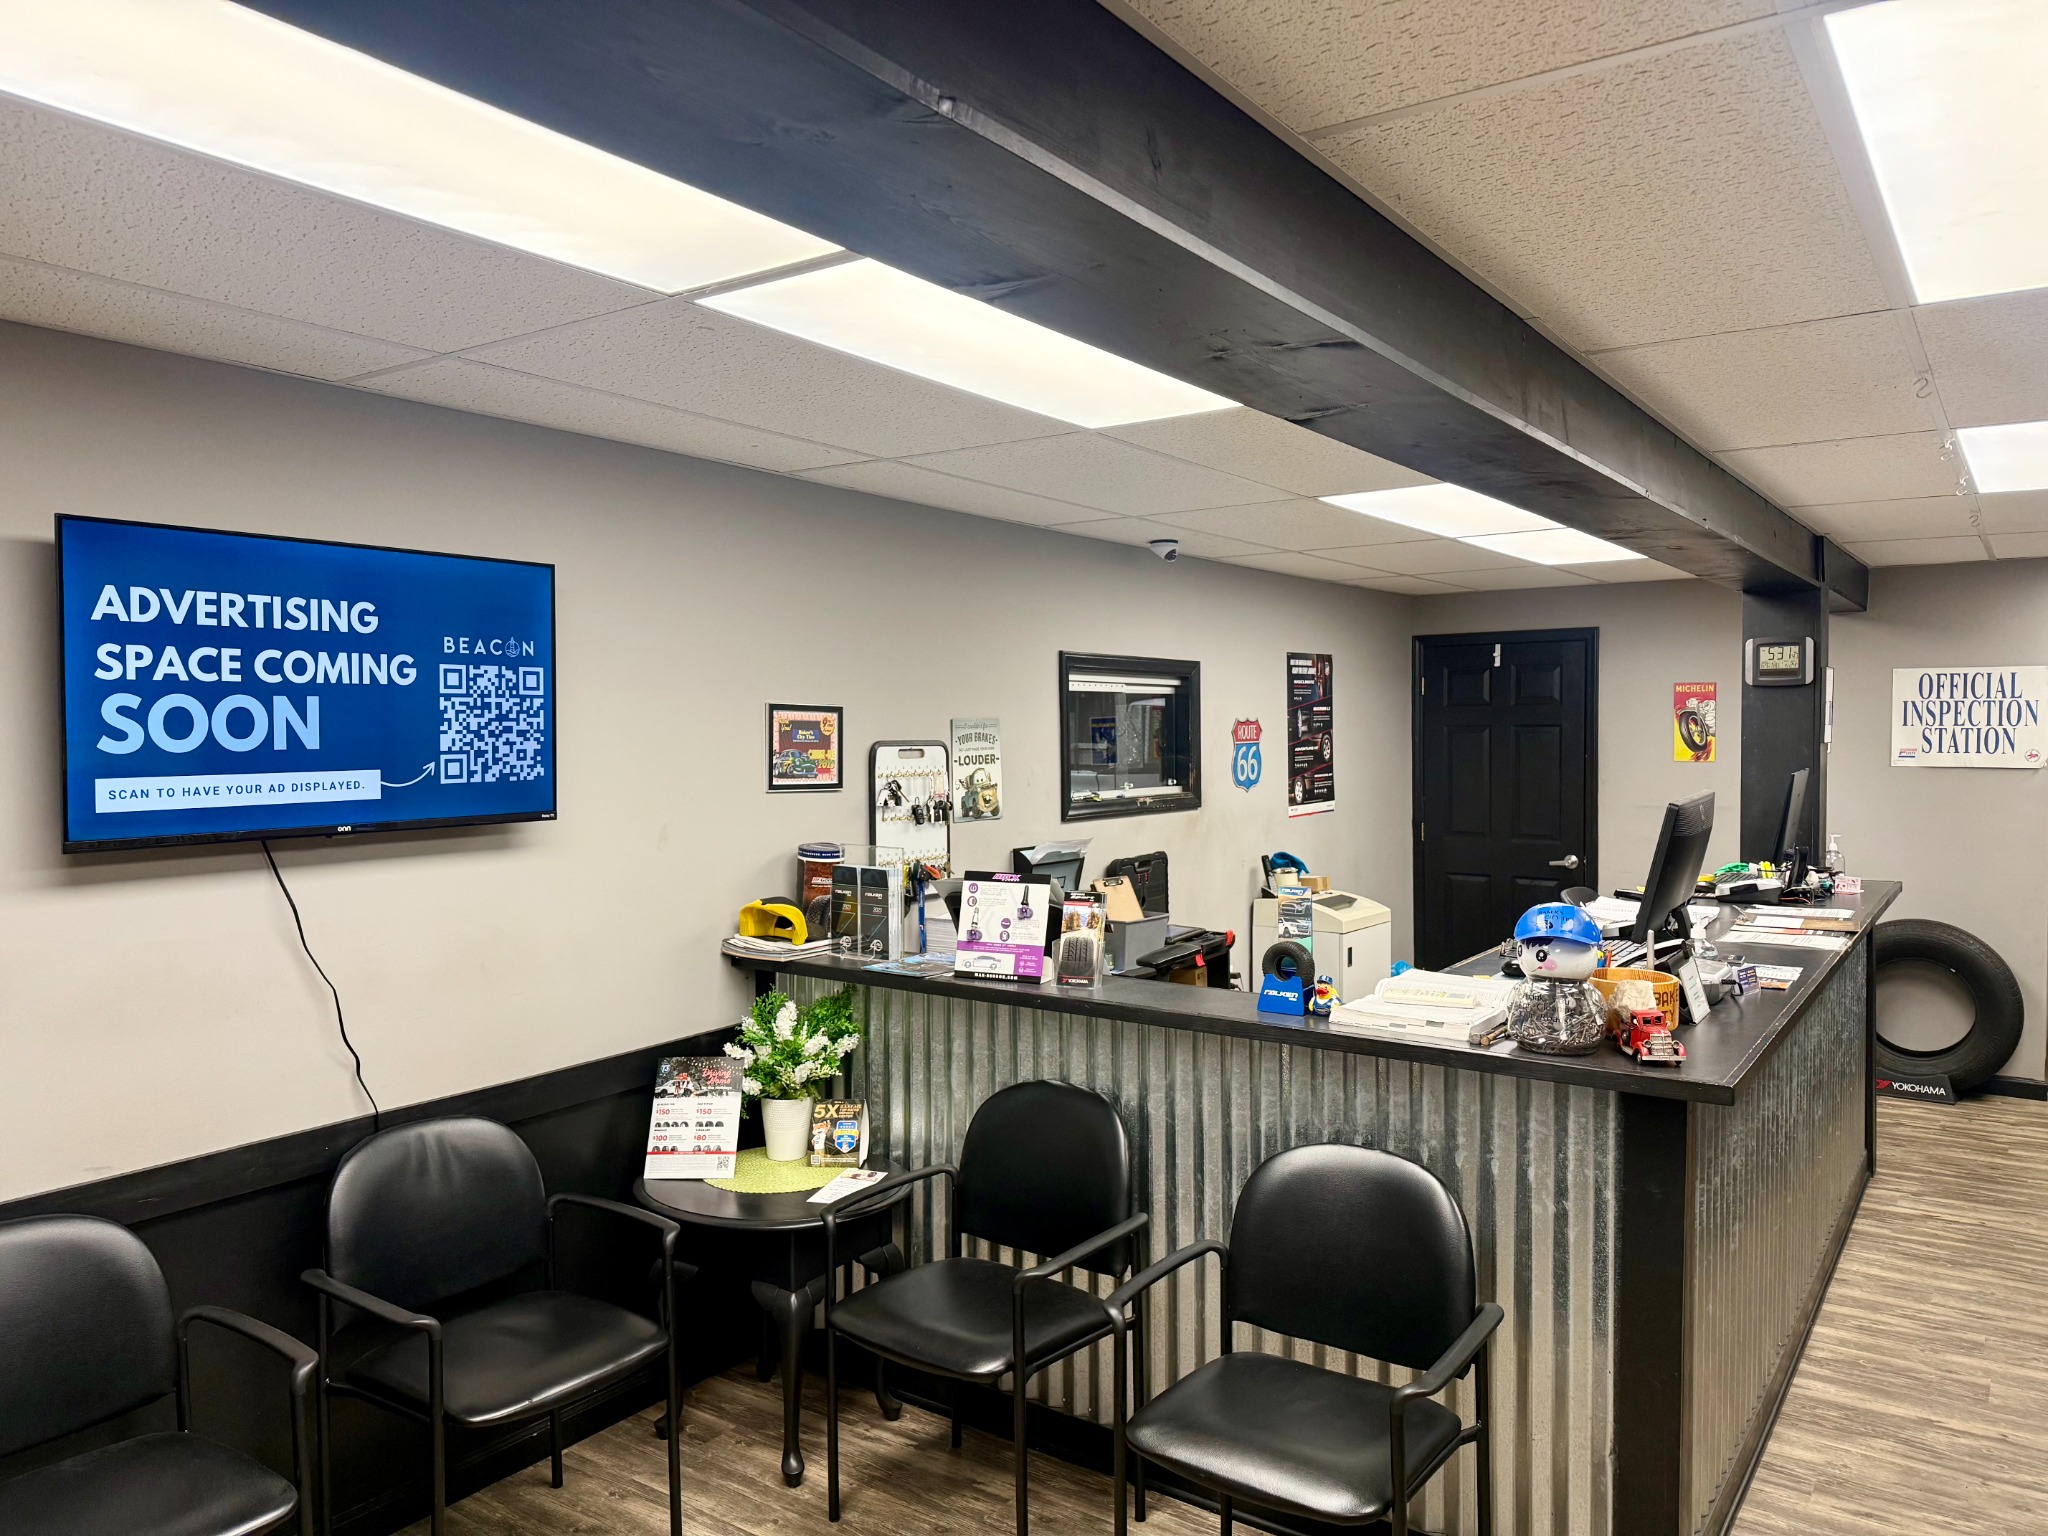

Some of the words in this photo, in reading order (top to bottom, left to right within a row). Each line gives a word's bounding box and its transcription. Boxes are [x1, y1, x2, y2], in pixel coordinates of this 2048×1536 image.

[91, 584, 379, 634] ADVERTISING
[443, 636, 534, 657] BEACON
[95, 643, 242, 682] SPACE
[254, 650, 417, 686] COMING
[1918, 672, 2023, 699] OFFICIAL
[96, 692, 321, 754] SOON
[1902, 700, 2039, 726] INSPECTION
[957, 732, 973, 745] YOUR
[974, 732, 996, 745] BRAKES
[1237, 724, 1257, 740] ROUTE
[1922, 727, 2016, 754] STATION
[958, 754, 996, 766] LOUDER
[1237, 746, 1258, 782] 66
[108, 788, 149, 800] SCAN
[156, 787, 175, 798] TO
[182, 785, 220, 797] HAVE
[226, 784, 262, 795] YOUR
[268, 783, 285, 794] AD
[291, 780, 365, 792] DISPLAYED.
[1264, 989, 1299, 999] FALKEN
[1892, 1081, 1946, 1096] YOKOHAMA
[814, 1104, 840, 1119] 5X
